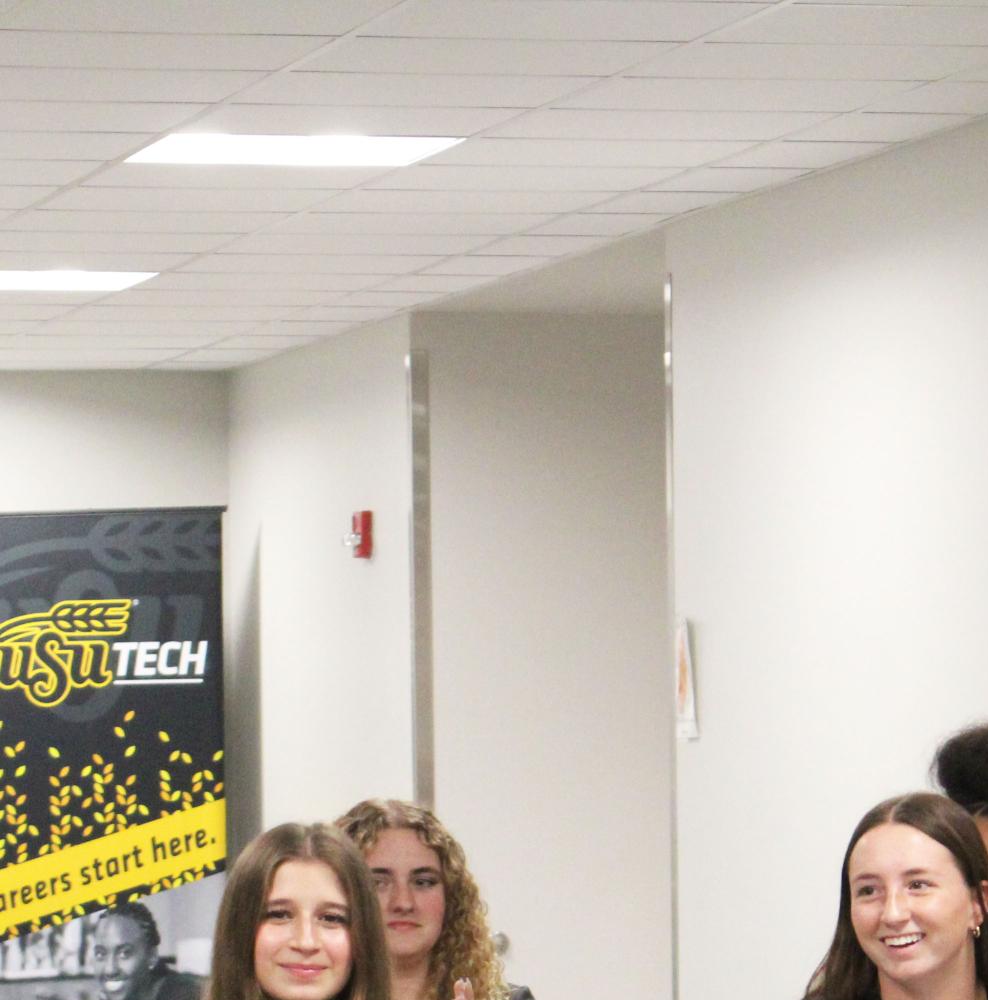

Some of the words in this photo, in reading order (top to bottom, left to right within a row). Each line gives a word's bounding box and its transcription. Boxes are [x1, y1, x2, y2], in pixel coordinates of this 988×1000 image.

[112, 640, 209, 678] TECH
[80, 845, 144, 886] start
[151, 827, 217, 864] here.
